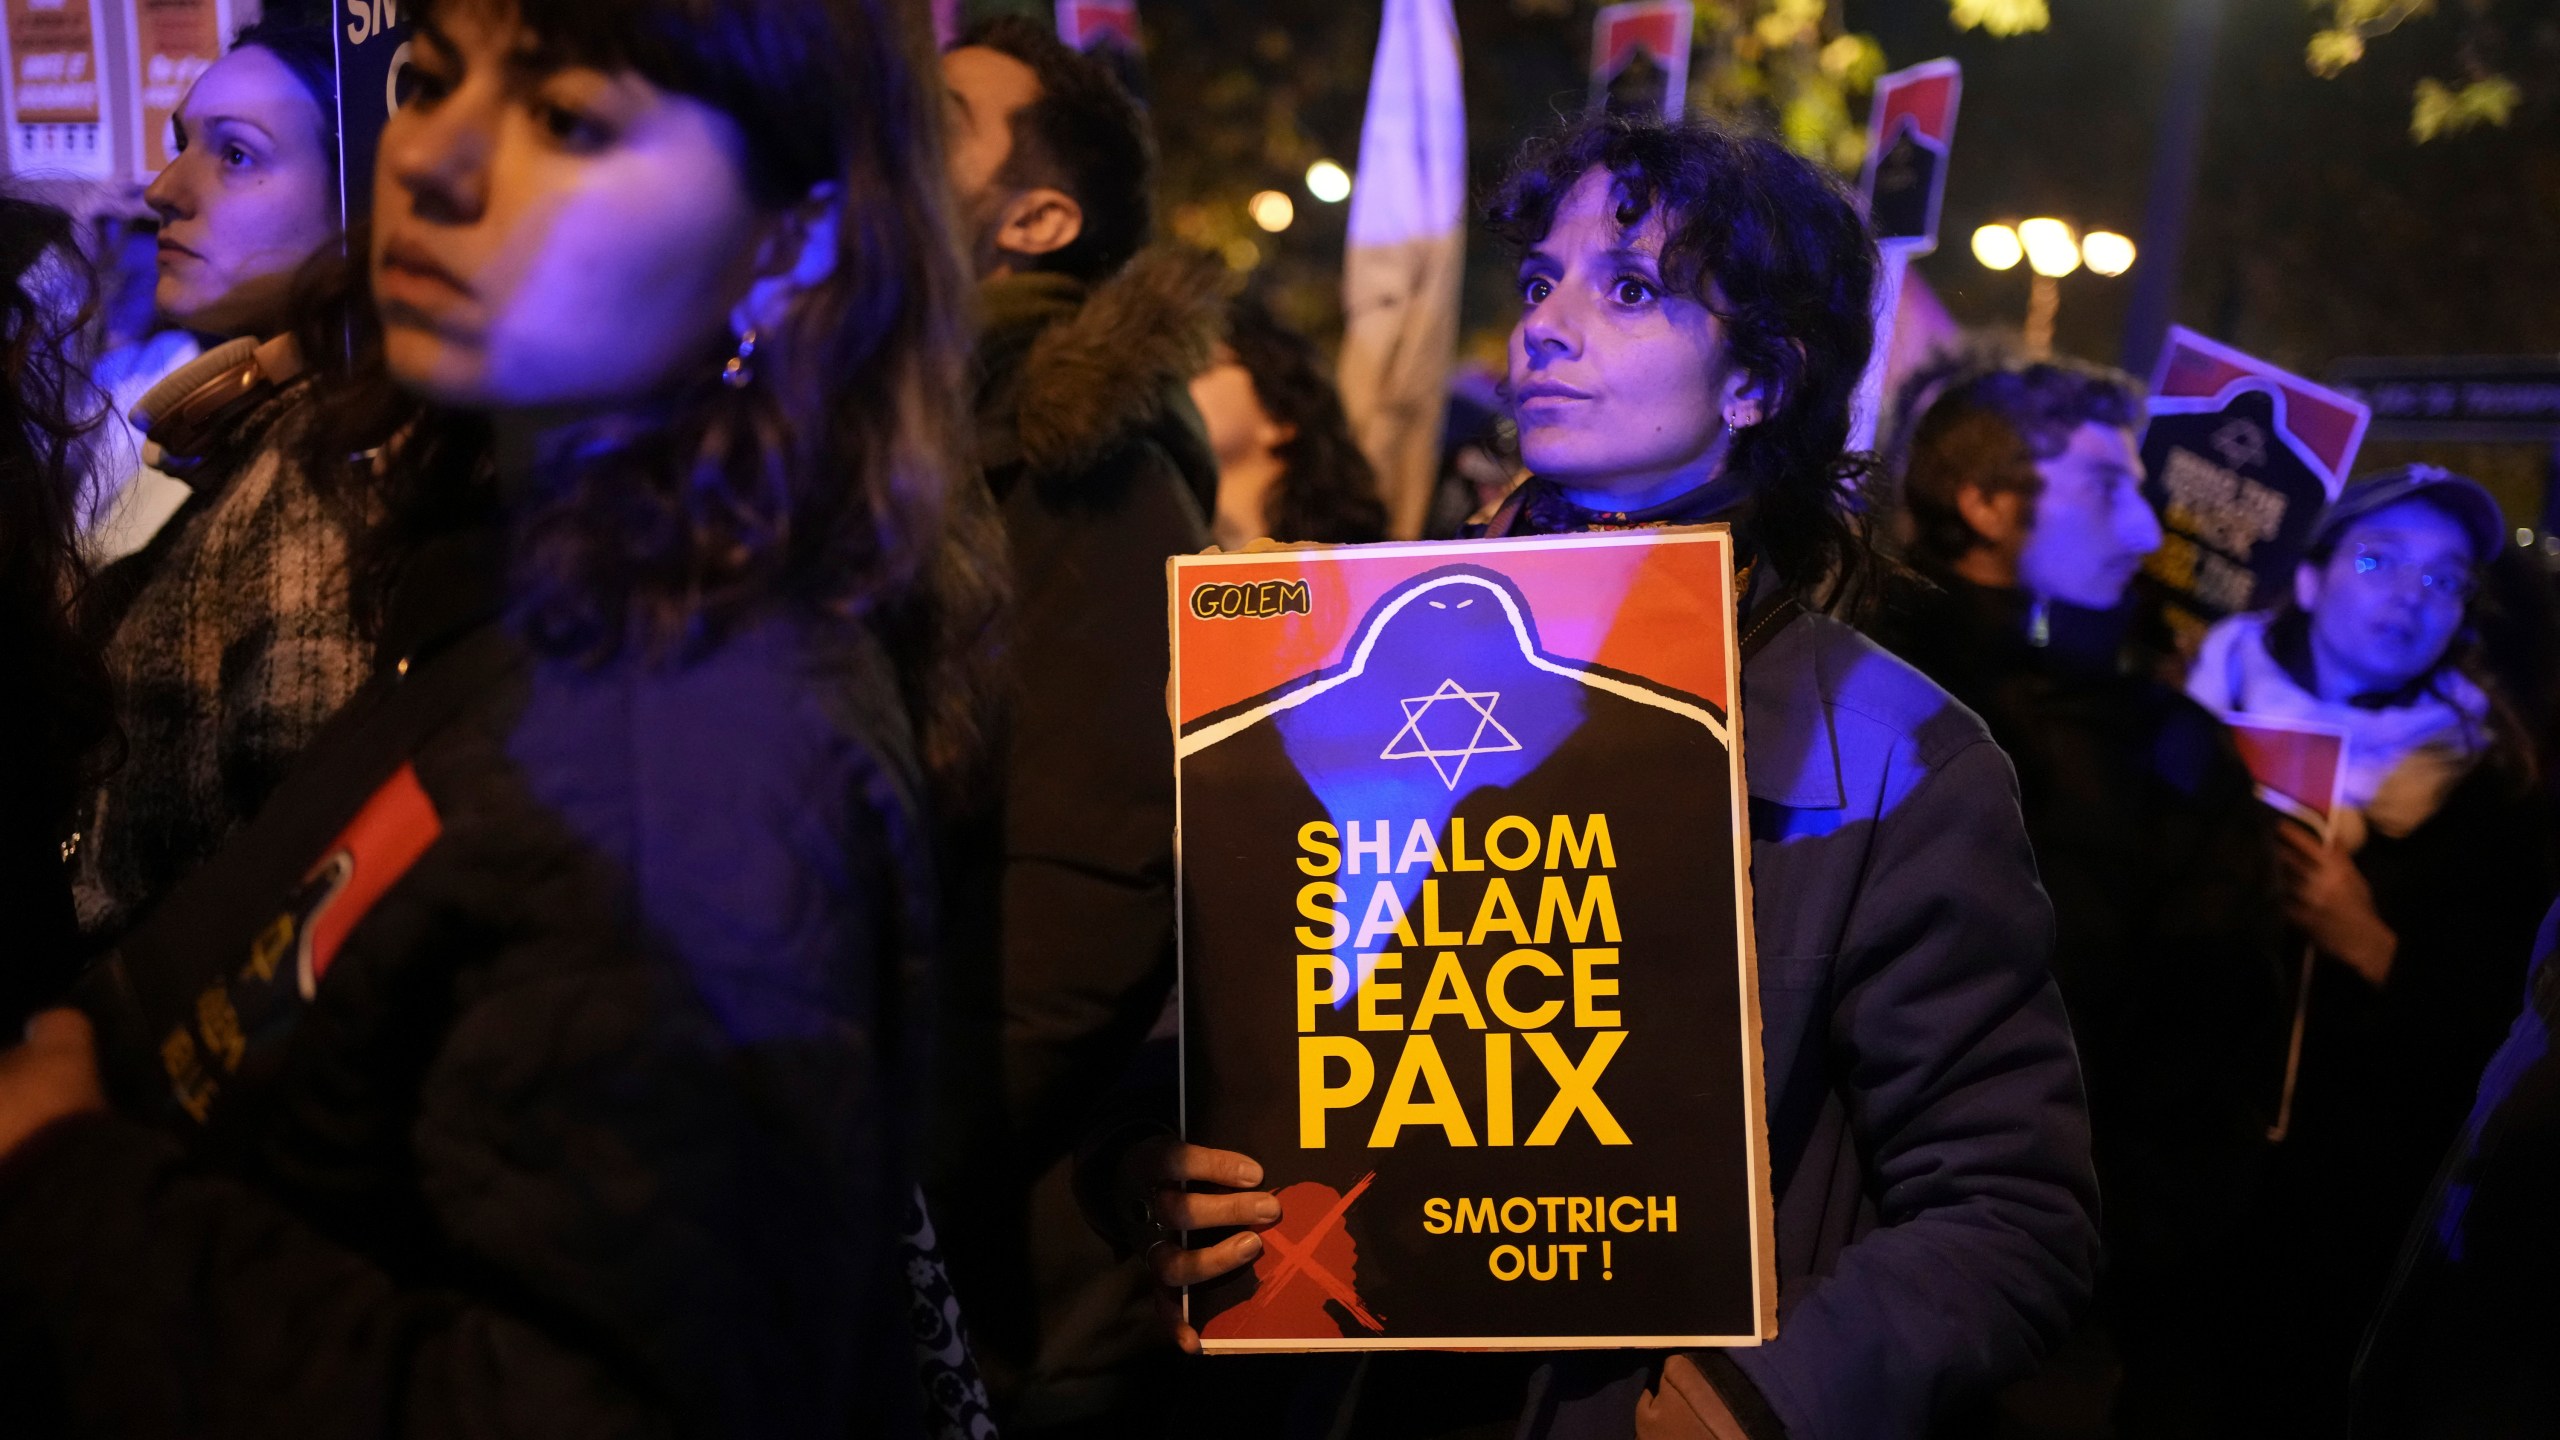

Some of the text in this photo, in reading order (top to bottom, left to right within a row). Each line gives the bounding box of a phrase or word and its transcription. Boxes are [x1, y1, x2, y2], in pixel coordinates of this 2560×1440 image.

[1196, 585, 1307, 616] GOLEM
[1295, 813, 1617, 877] SHALOM
[1294, 874, 1623, 951] SALAM
[1296, 947, 1622, 1033] PEACE
[1298, 1030, 1633, 1149] PAIX
[1422, 1195, 1678, 1235] SMOTRICH
[1488, 1243, 1588, 1282] OUT
